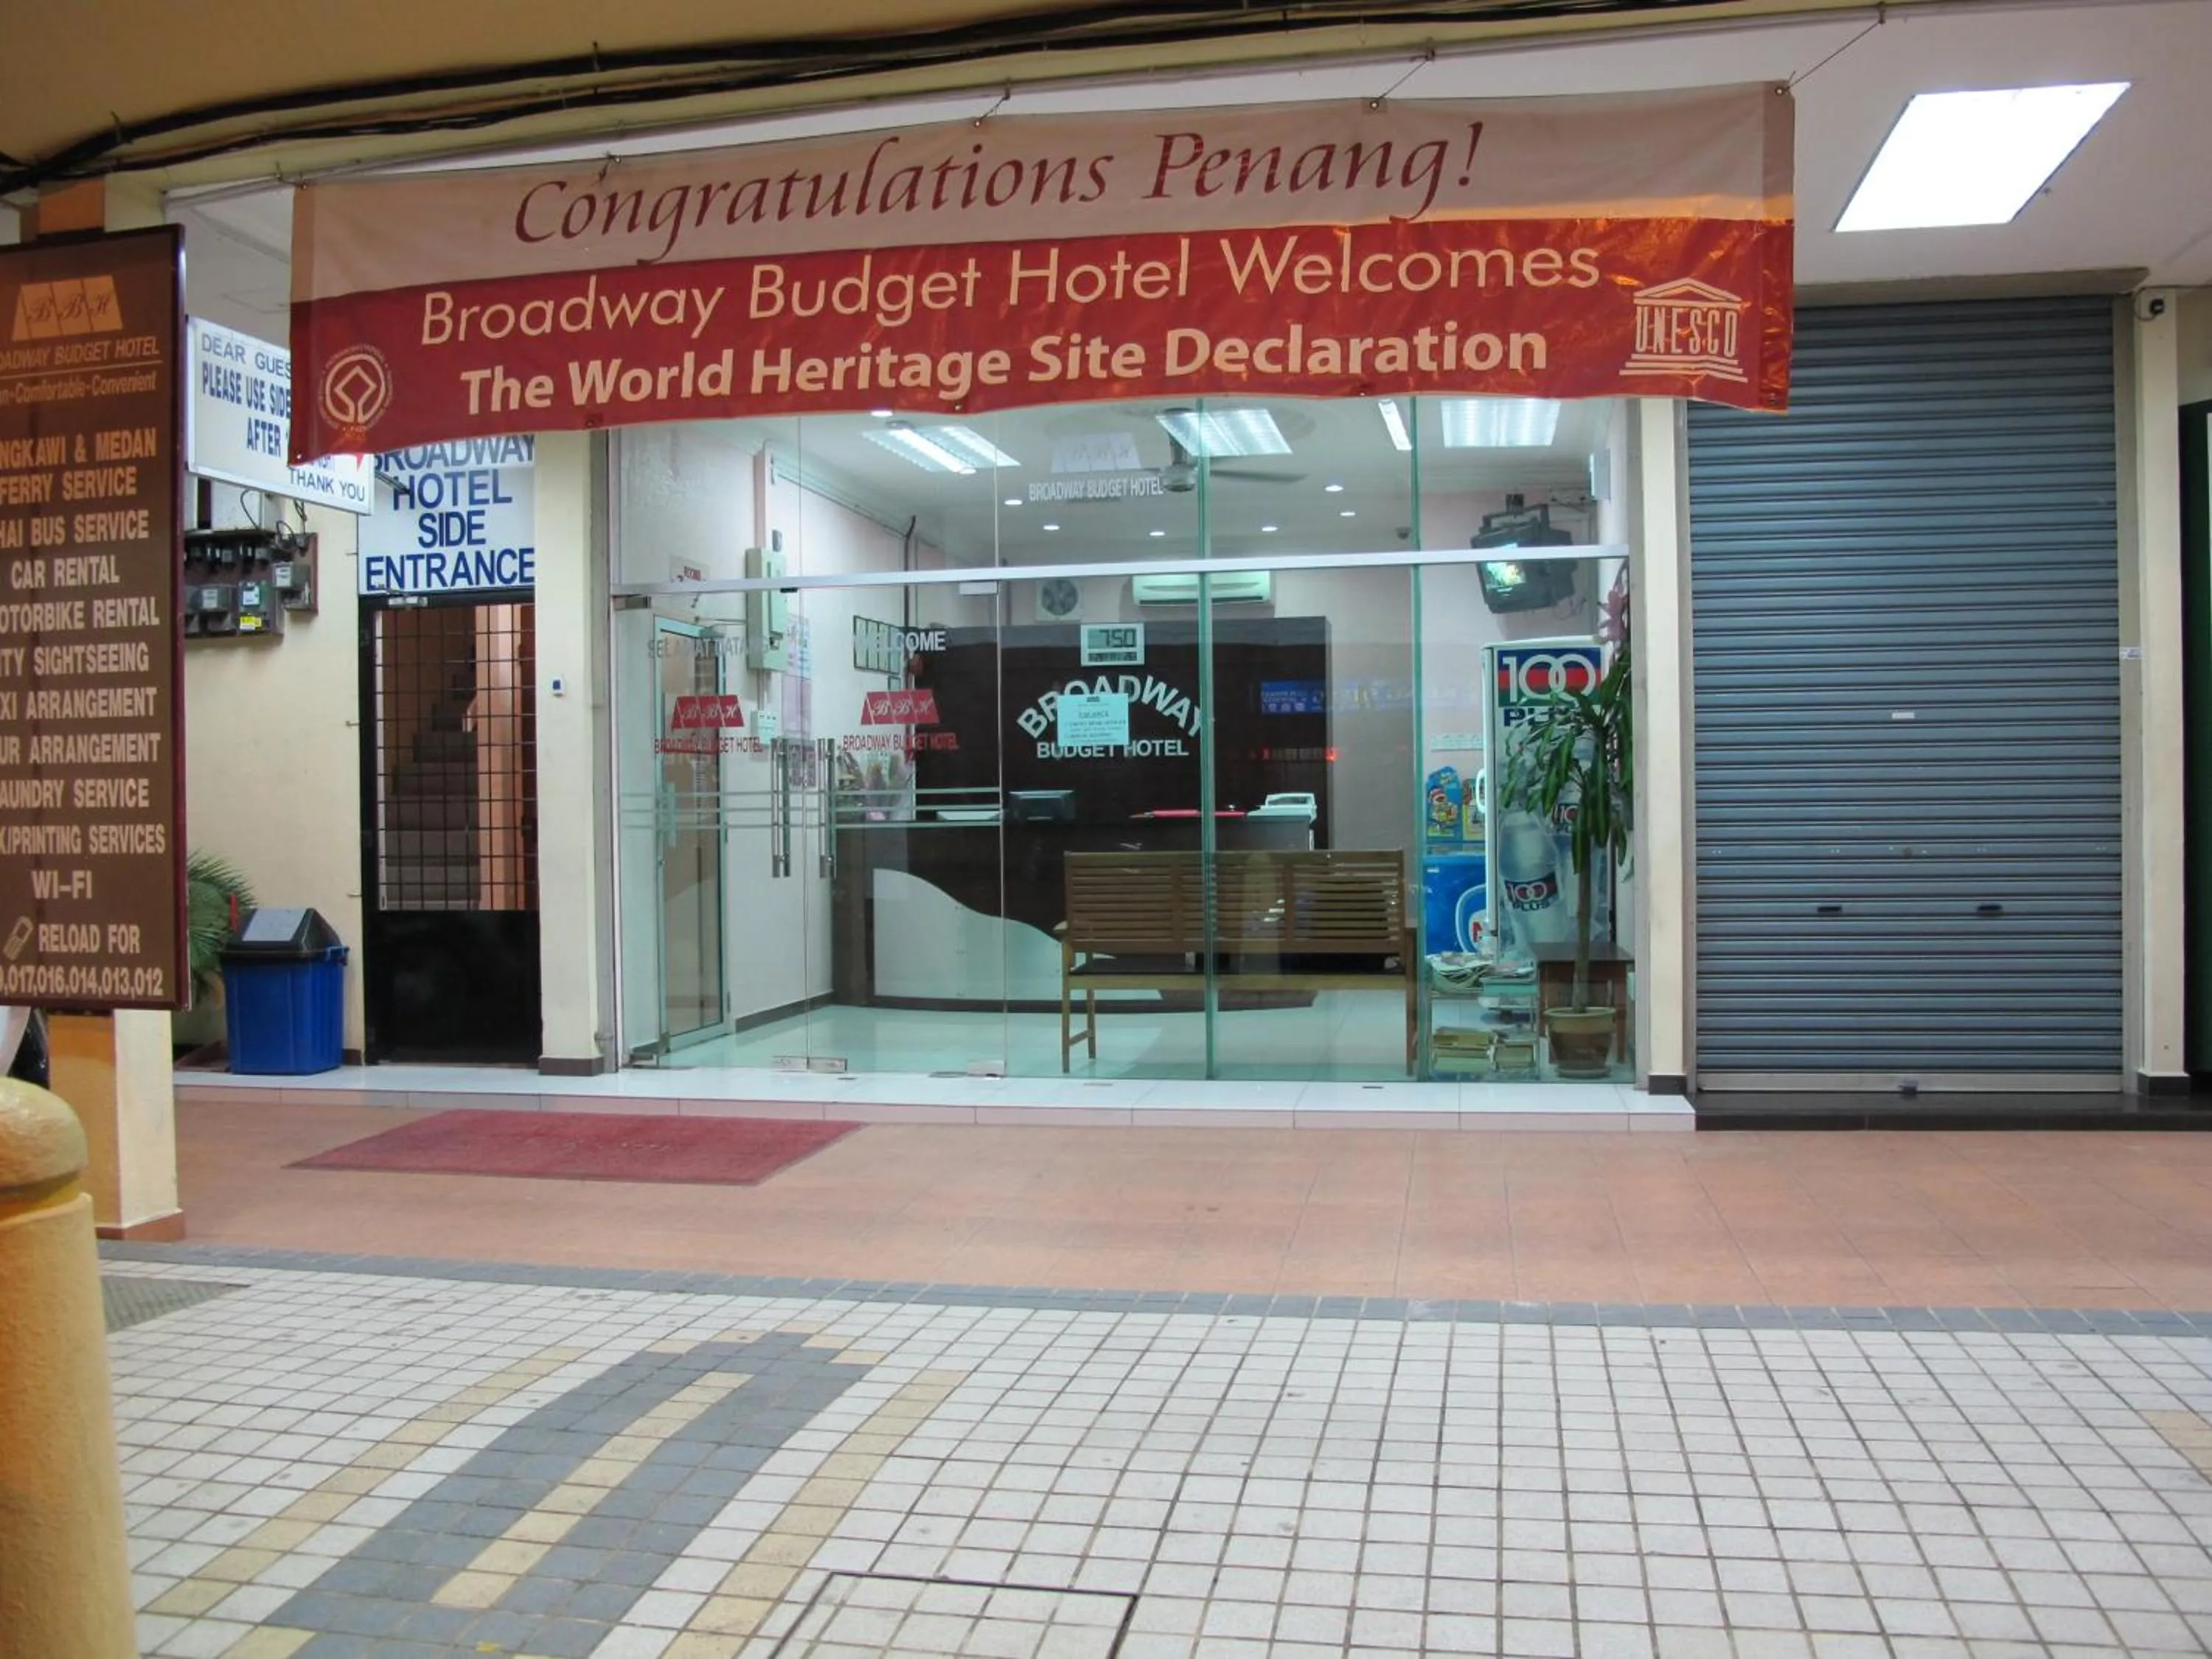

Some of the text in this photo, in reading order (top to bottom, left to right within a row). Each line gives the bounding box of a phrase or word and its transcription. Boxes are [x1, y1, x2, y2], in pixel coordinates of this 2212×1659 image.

[516, 122, 1483, 265] Congratulations Penang!
[422, 233, 1599, 344] Broadway Budget Hotel Welcomes
[202, 333, 246, 364] DEAR
[1636, 307, 1736, 357] UNESCO
[55, 341, 110, 365] BUDGET
[115, 336, 160, 359] HOTEL
[460, 321, 1546, 414] The World Heritage Site Declaration
[203, 361, 291, 419] PLEASE USE SIDE
[74, 434, 87, 463] &
[96, 428, 156, 462] MEDAN
[247, 417, 281, 457] AFTER
[0, 466, 137, 505] FERRY SERVICE
[290, 467, 364, 501] THANK YOU
[394, 470, 512, 510] HOTEL
[1029, 476, 1164, 502] BROADWAY BUDGET HOTEL
[31, 516, 66, 546] BUS
[74, 509, 149, 543] SERVICE
[418, 509, 486, 548] SIDE
[12, 554, 119, 589] CAR RENTAL
[366, 548, 535, 591] ENTRANCE
[0, 597, 160, 633] OTORBIKE RENTAL
[34, 642, 149, 675] SIGHTSEEING
[1503, 654, 1596, 703] 100
[27, 687, 157, 720] ARRANGEMENT
[29, 733, 161, 764] ARRANGEMENT
[737, 737, 762, 753] HOTEL
[843, 734, 891, 751] BROADWAY
[1037, 740, 1189, 759] BUDGET HOTEL
[74, 779, 150, 808] SERVICE
[88, 824, 165, 854] SERVICES
[31, 870, 92, 899] WI-FI
[38, 923, 141, 954] RELOAD FOR
